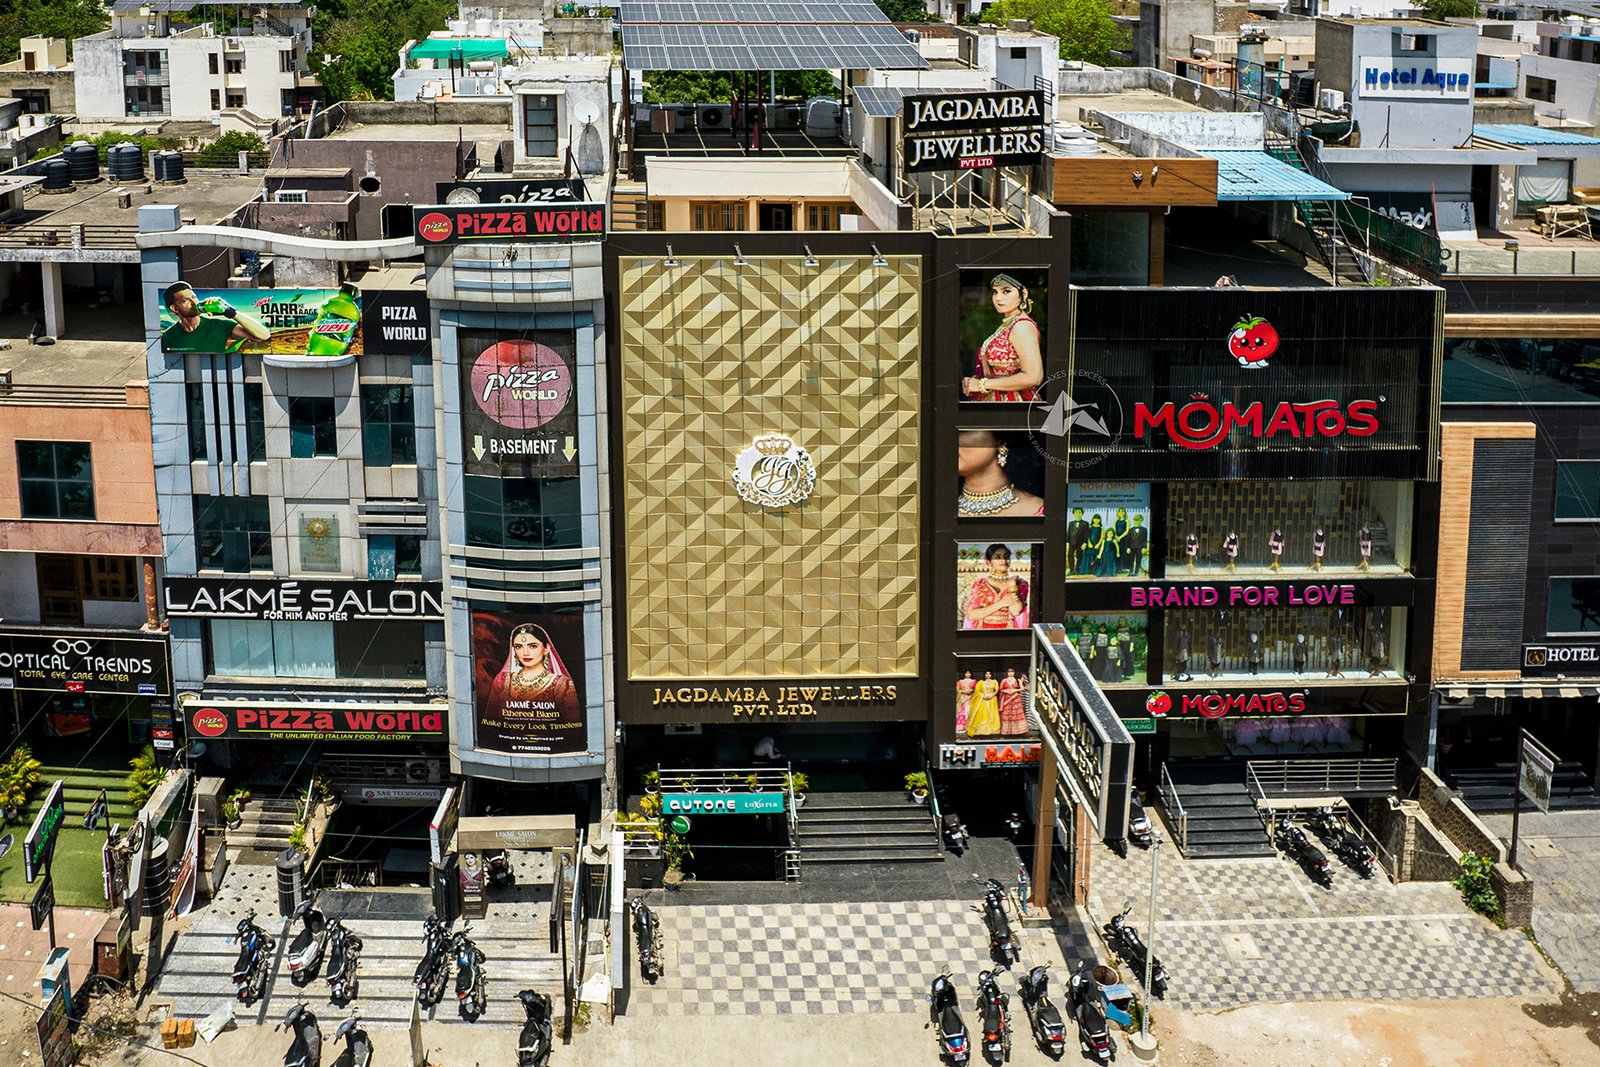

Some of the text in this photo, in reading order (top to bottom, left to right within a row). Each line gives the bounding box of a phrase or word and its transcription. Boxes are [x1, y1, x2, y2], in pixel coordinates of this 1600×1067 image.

[1365, 67, 1470, 90] Hotel Aqua
[908, 95, 1041, 129] JAGDAMBA
[909, 132, 1042, 167] JEWELLERS
[960, 157, 993, 168] PVT LTD
[260, 303, 298, 315] DARR
[382, 306, 418, 321] PIZZA
[383, 326, 427, 341] WORLD
[482, 365, 561, 402] pizza
[511, 389, 559, 401] WORLD
[490, 438, 558, 455] BASEMENT
[165, 581, 444, 614] LAKMÉ SALON
[1130, 585, 1355, 607] BRAND FOR LOVE
[263, 610, 348, 622] FOR HIM AND HER
[1547, 647, 1600, 662] HOTEL
[0, 652, 153, 674] OPTICAL TRENDS
[19, 669, 129, 682] TOTAL EYE CARE CENTER
[653, 685, 898, 705] JAGDAMBA JEWELLERS
[532, 701, 556, 710] SALON
[732, 703, 818, 716] PVT. LTD.
[481, 718, 502, 728] Make
[503, 720, 527, 731] Every
[528, 722, 547, 731] Look
[550, 721, 584, 731] Timeless
[285, 732, 325, 740] UNLIMITED
